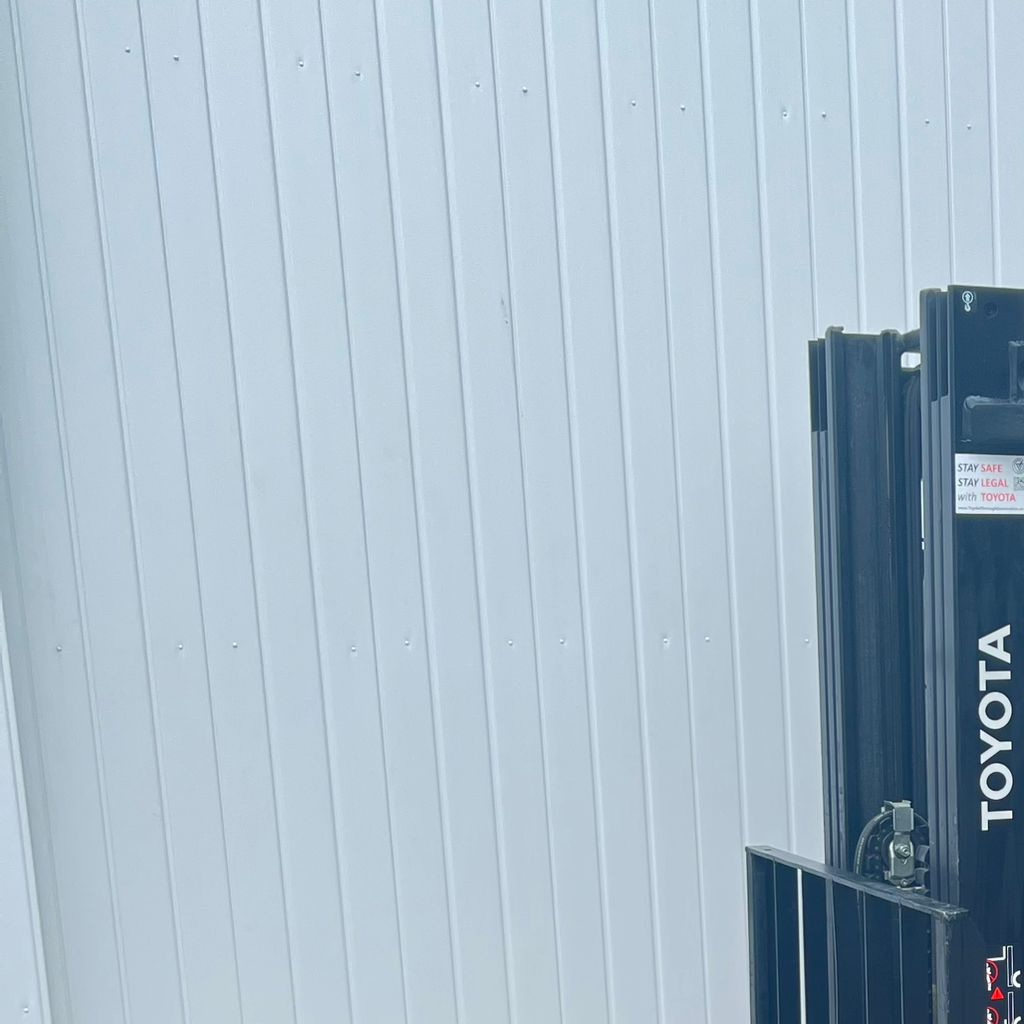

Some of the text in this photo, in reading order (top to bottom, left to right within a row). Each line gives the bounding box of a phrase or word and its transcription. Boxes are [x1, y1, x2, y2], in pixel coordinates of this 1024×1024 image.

[957, 463, 1003, 473] STAY SAFE
[957, 478, 1009, 488] STAY LEGAL
[957, 492, 1016, 502] with TOYOTA
[978, 624, 1014, 832] TOYOTA
